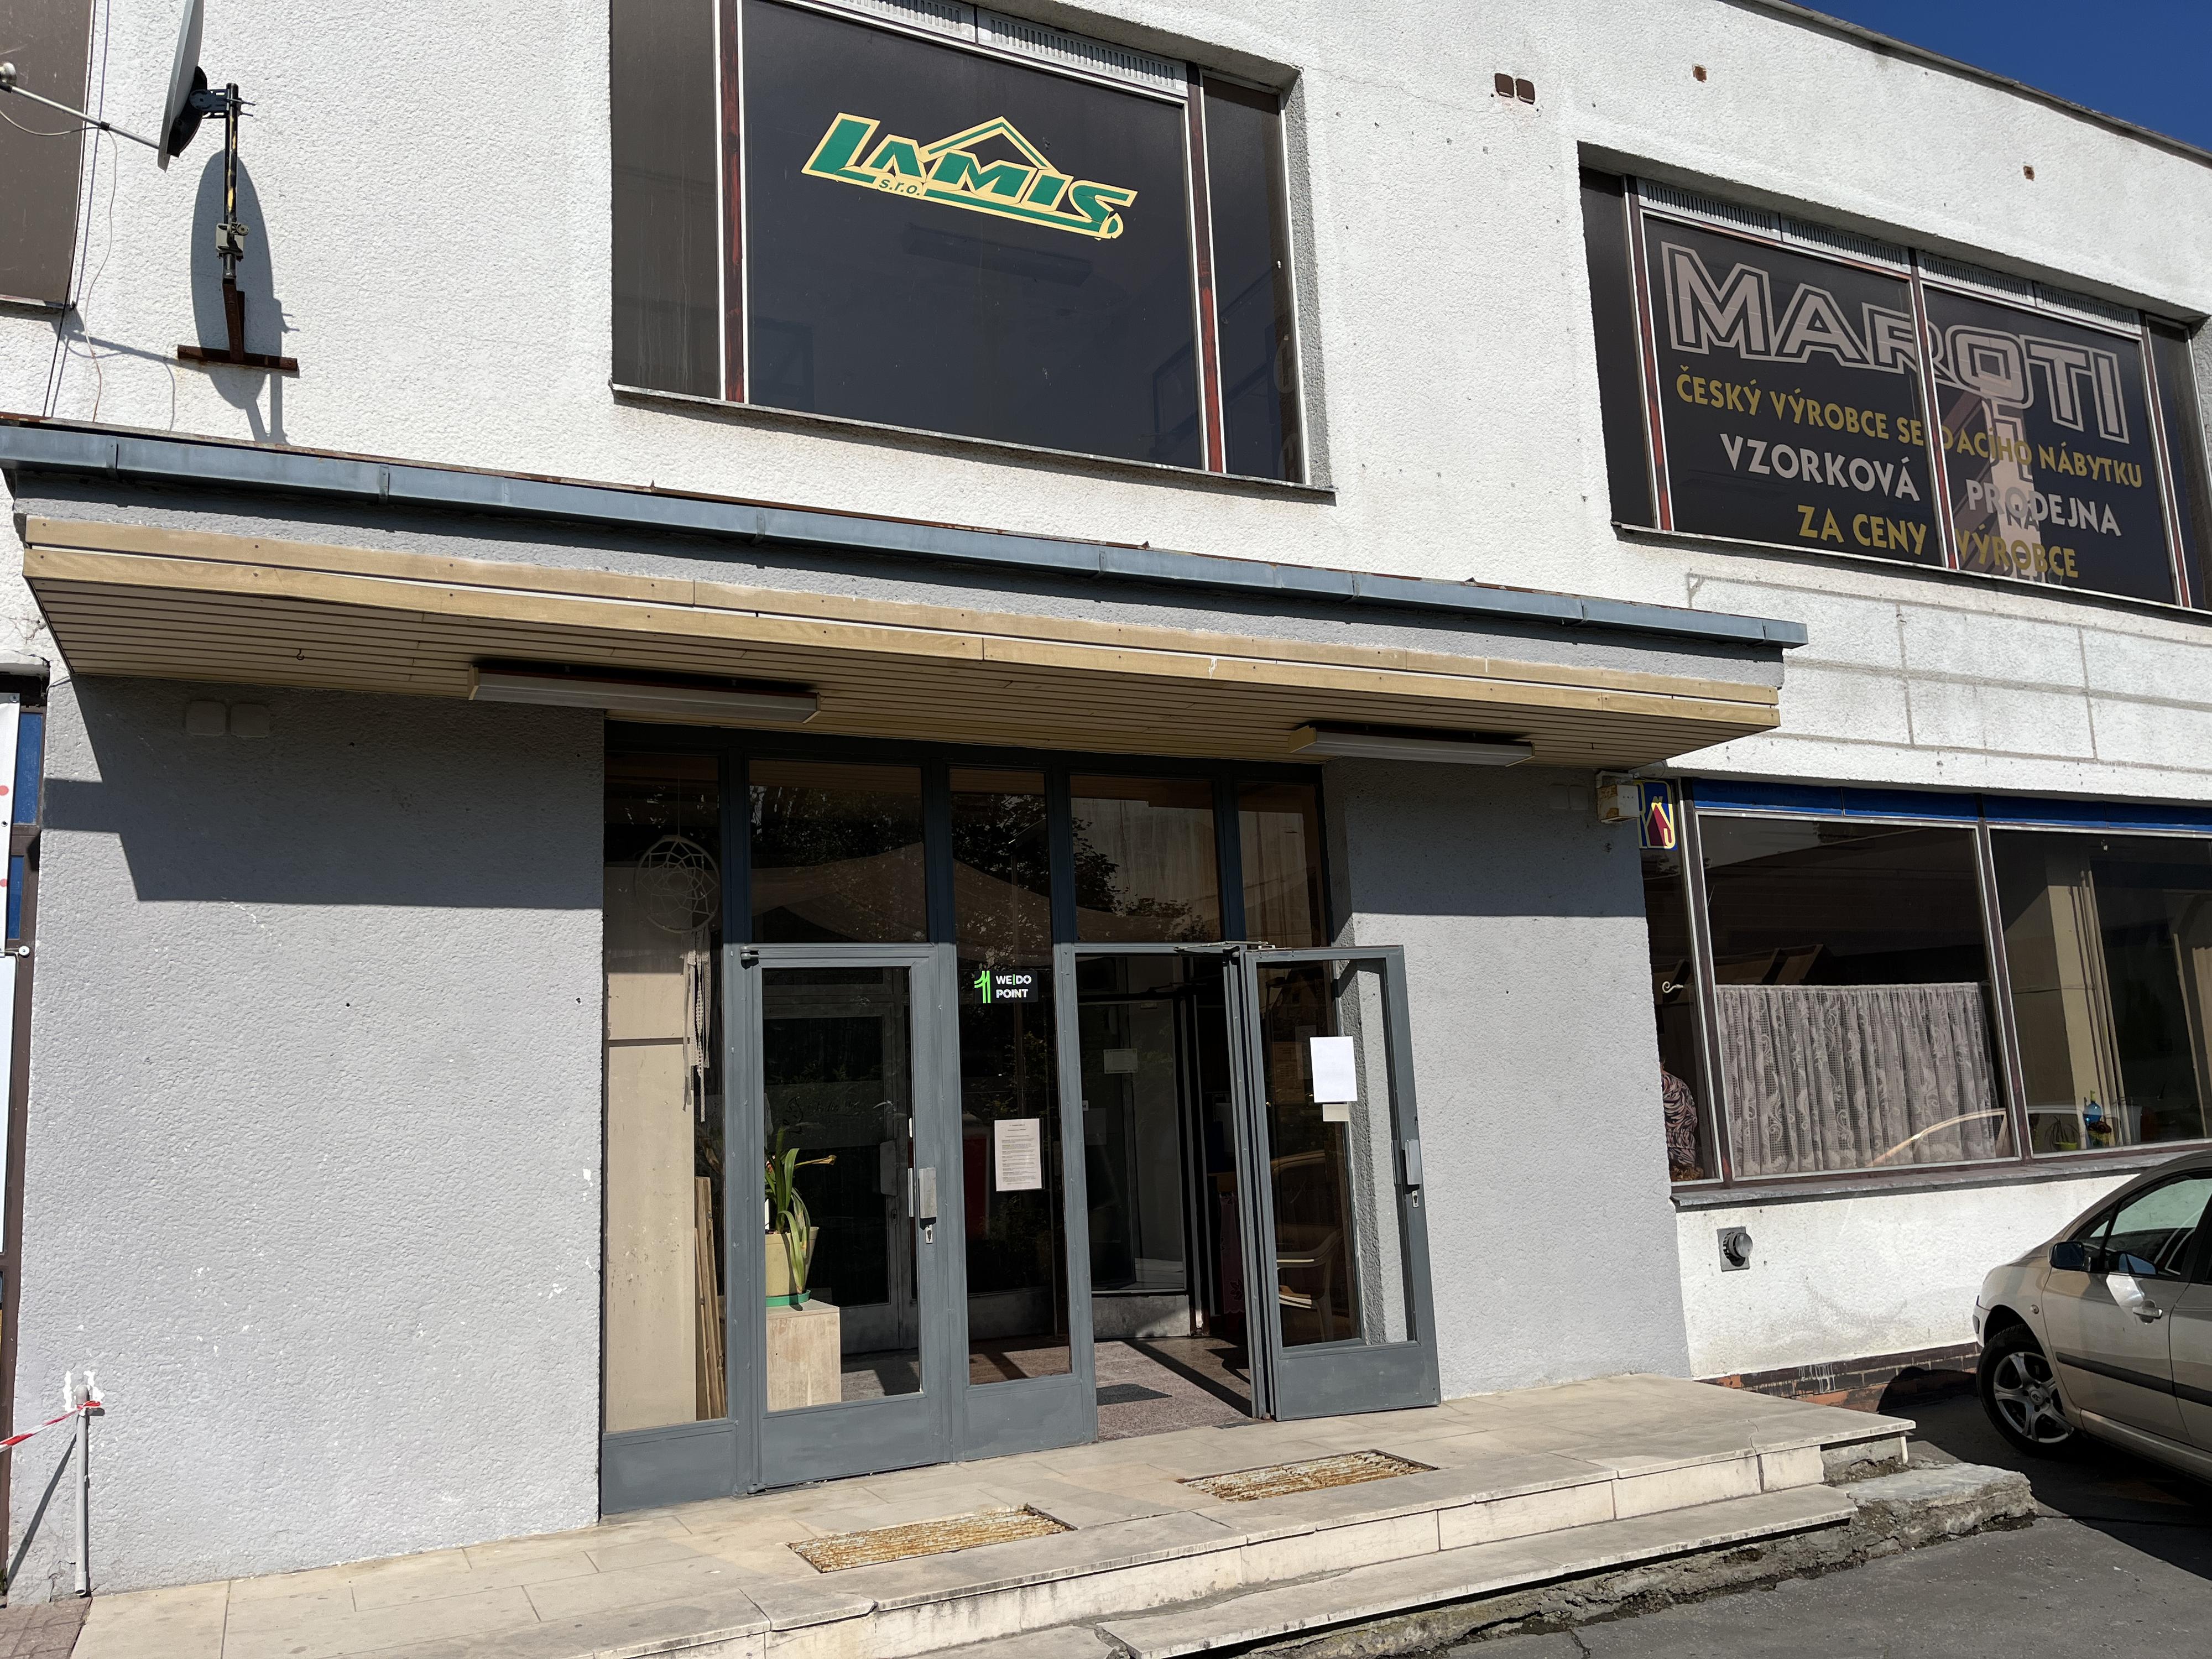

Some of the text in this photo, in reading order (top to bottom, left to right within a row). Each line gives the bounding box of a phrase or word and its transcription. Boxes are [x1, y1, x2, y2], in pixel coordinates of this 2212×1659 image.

[879, 178, 920, 196] s.r.o.
[1661, 241, 2129, 444] MAROTI
[1676, 365, 1762, 416] ČESKÝ
[1769, 388, 1888, 439] VÝROBCE
[2038, 441, 2143, 488] NÁBYTKU
[1720, 433, 2122, 537] VZORKOVÁ PRODEJNA
[1797, 505, 2079, 578] ZA CENY VÝROBCE
[996, 989, 1029, 998] POINT
